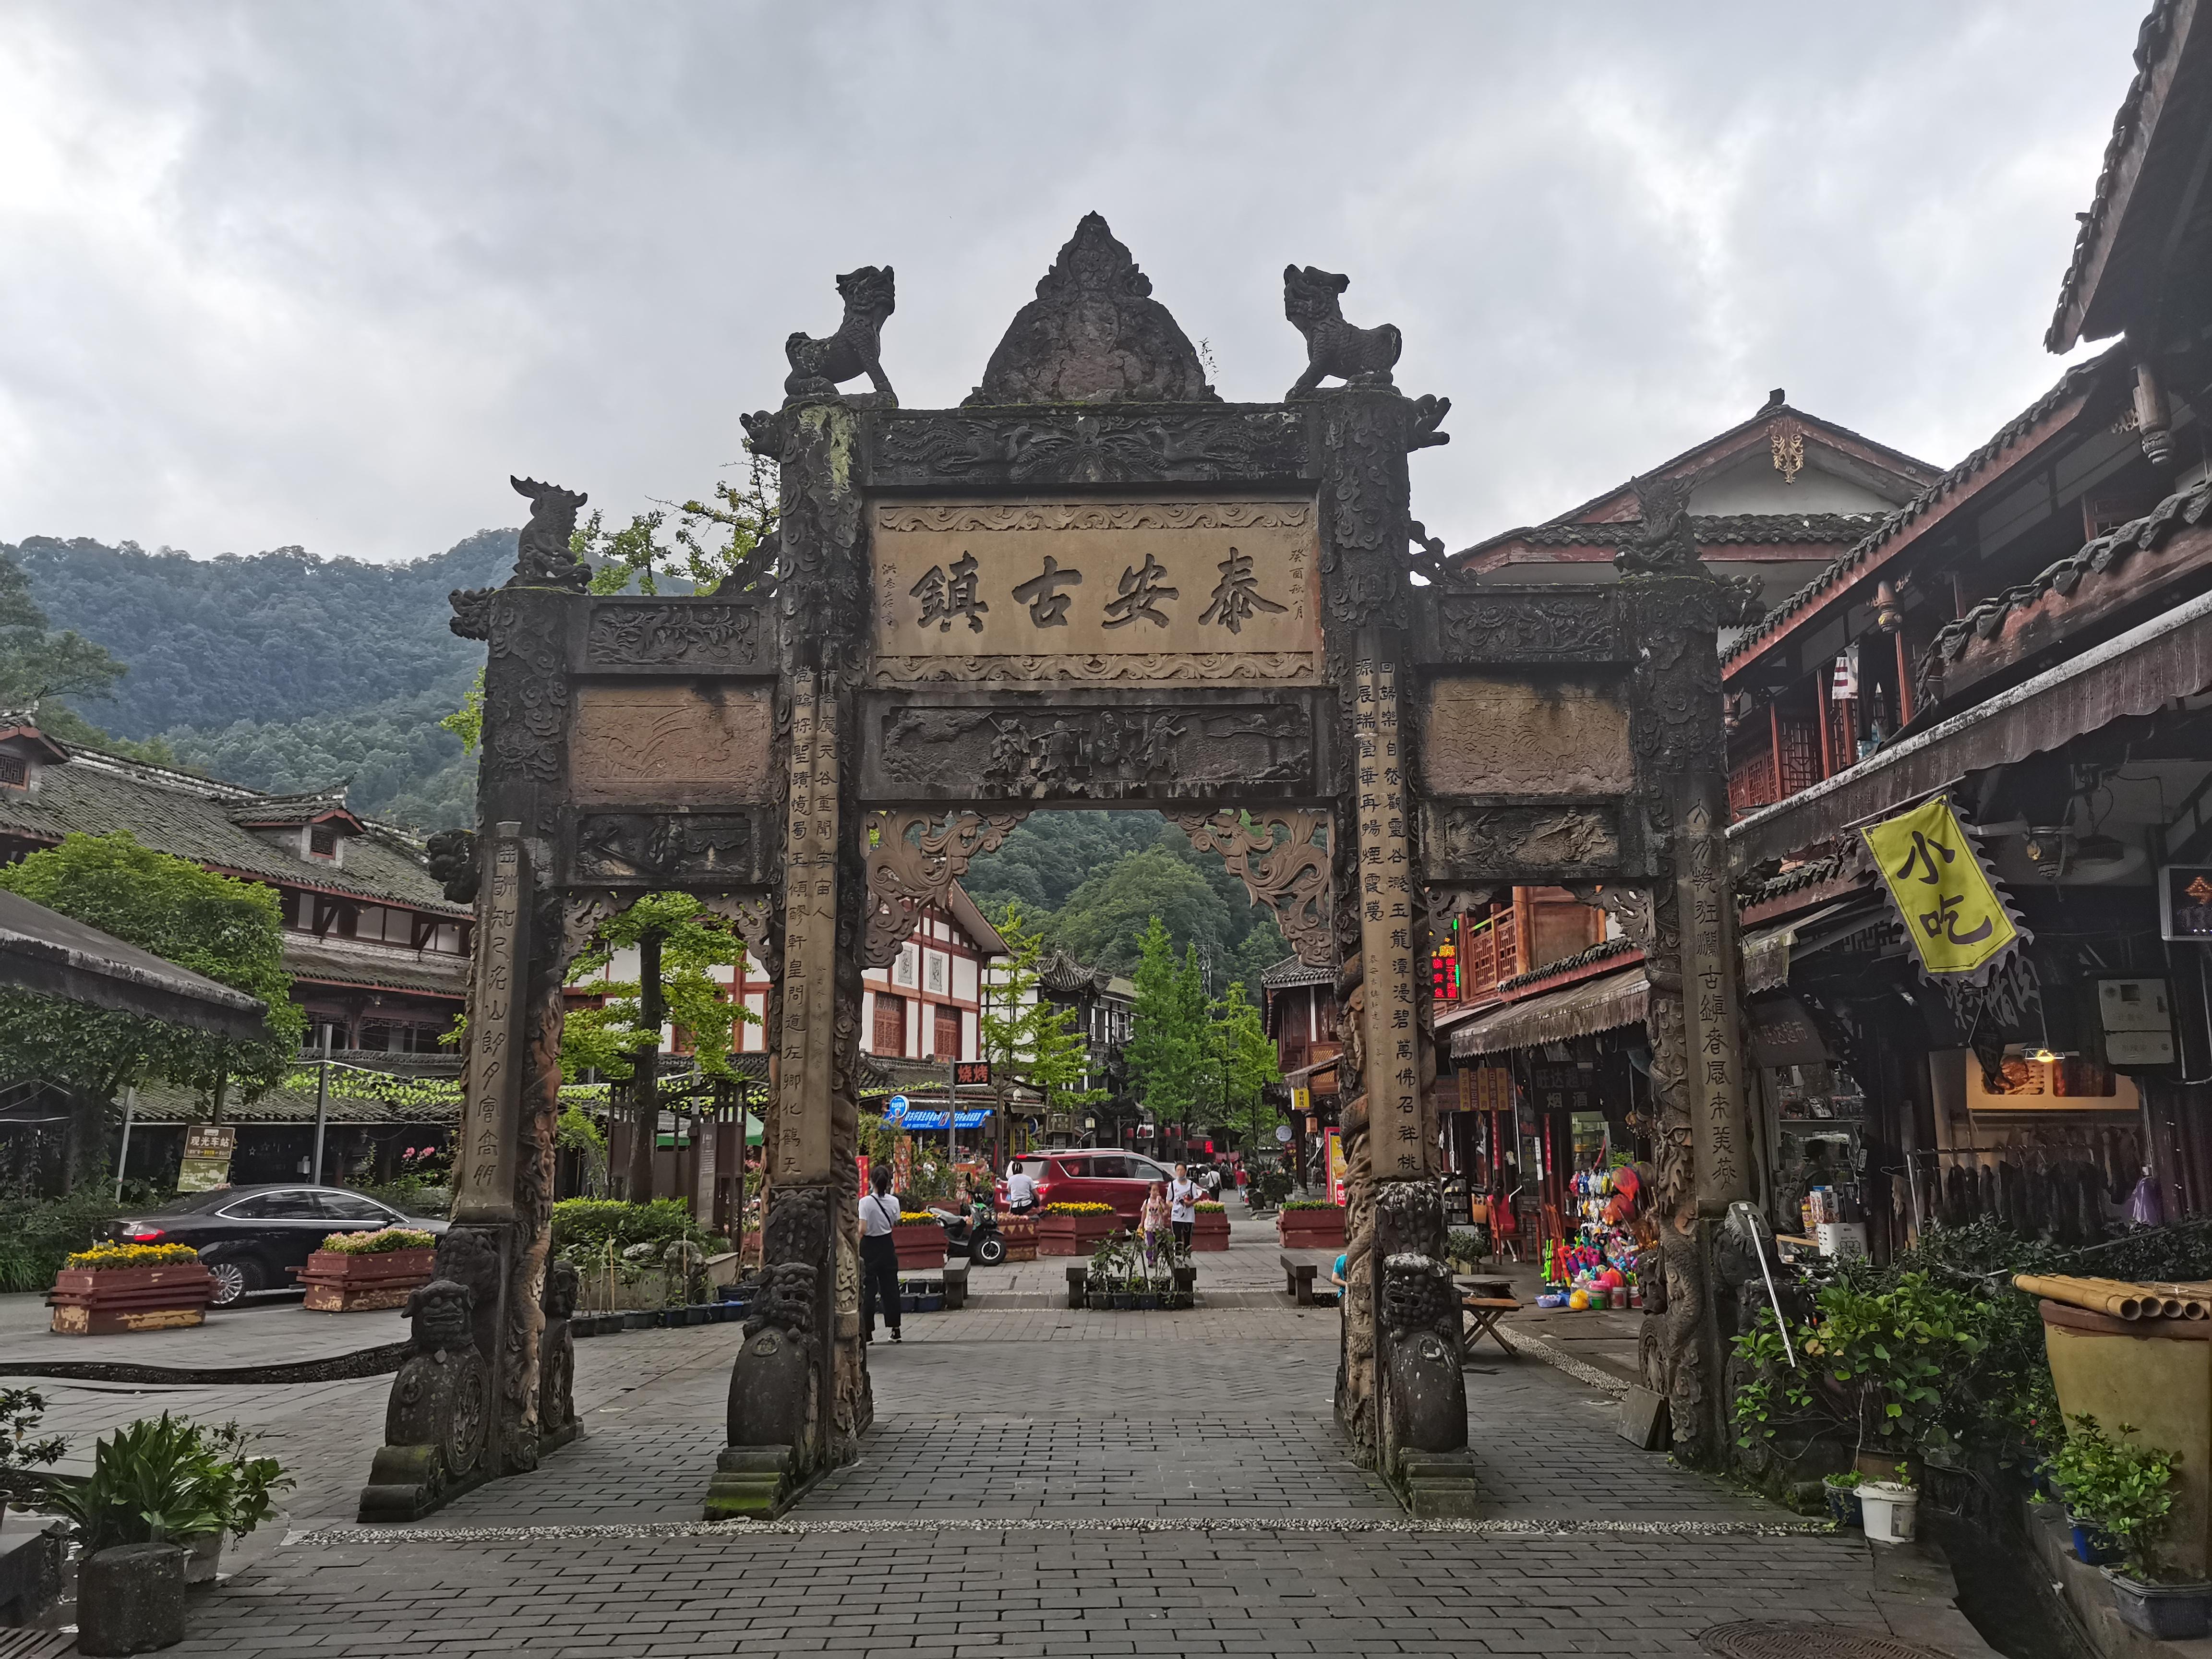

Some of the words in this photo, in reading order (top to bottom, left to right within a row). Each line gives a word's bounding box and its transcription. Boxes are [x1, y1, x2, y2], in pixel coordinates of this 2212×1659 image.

[910, 547, 1288, 634] 泰安古鎮
[1897, 831, 1993, 945] 小吃
[958, 1064, 988, 1083] 烧烤
[1546, 1091, 1587, 1108] 烟酒
[191, 1136, 230, 1147] 观光车站
